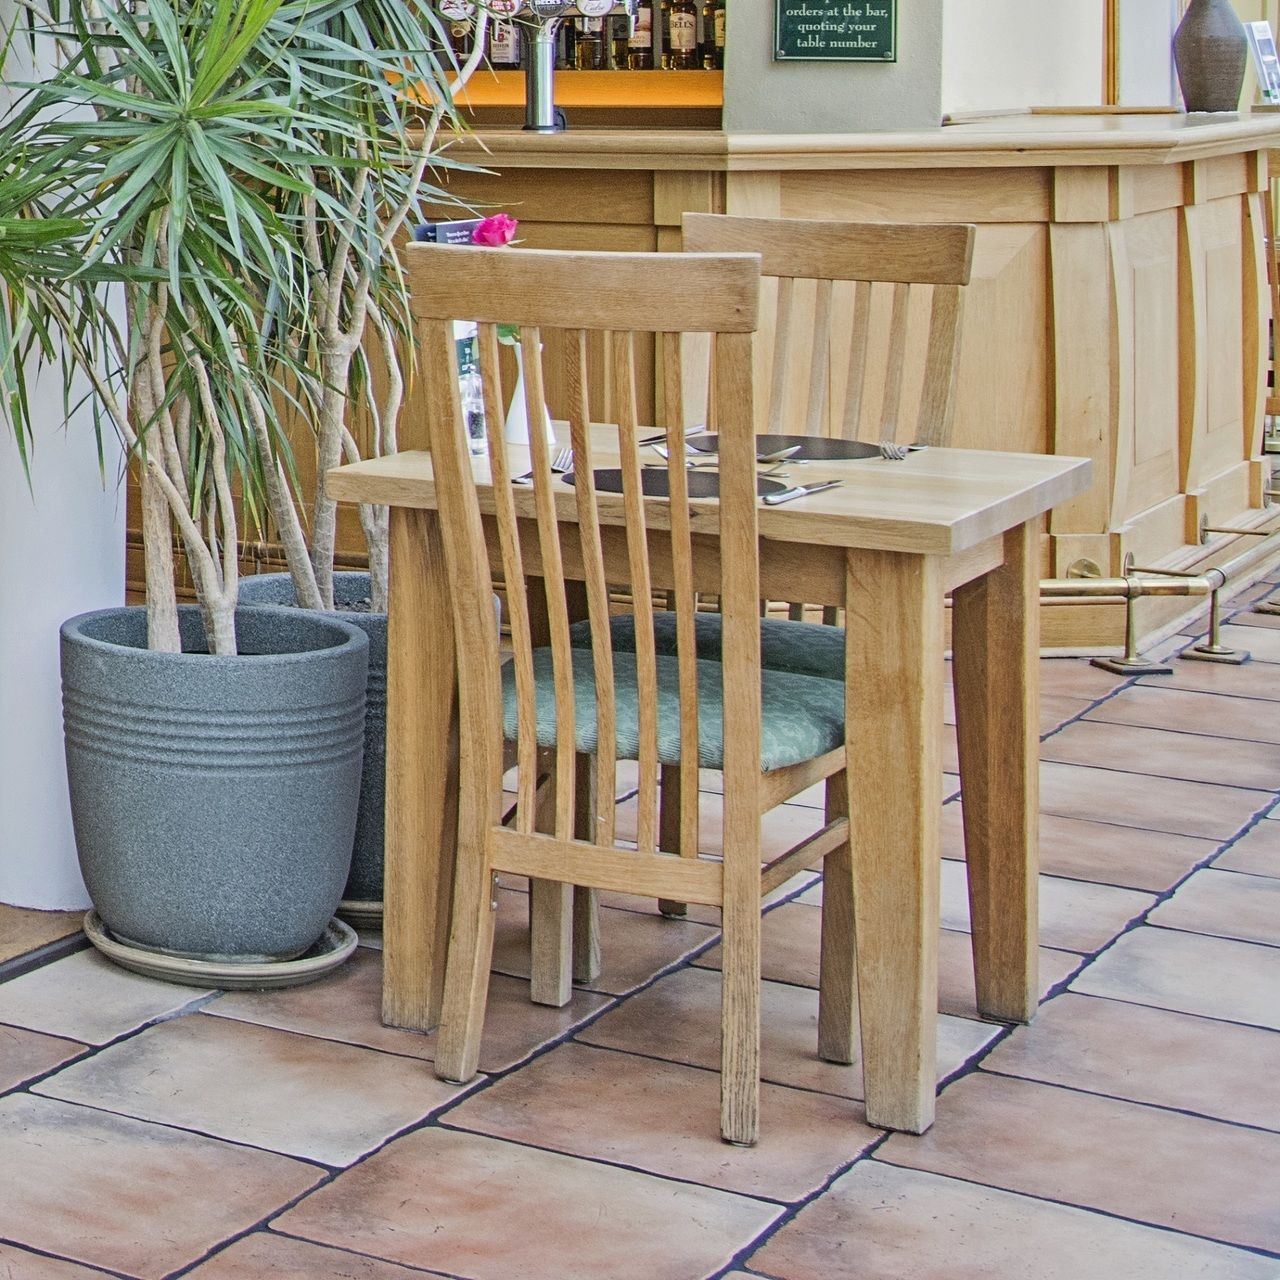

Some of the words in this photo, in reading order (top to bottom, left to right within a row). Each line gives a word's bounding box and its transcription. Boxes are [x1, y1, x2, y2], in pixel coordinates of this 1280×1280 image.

[786, 4, 823, 16] orders
[827, 6, 840, 16] at
[843, 4, 862, 16] the
[866, 3, 888, 18] bar,
[798, 22, 844, 33] quoting
[848, 22, 877, 32] your
[797, 37, 826, 48] table
[830, 38, 877, 48] number
